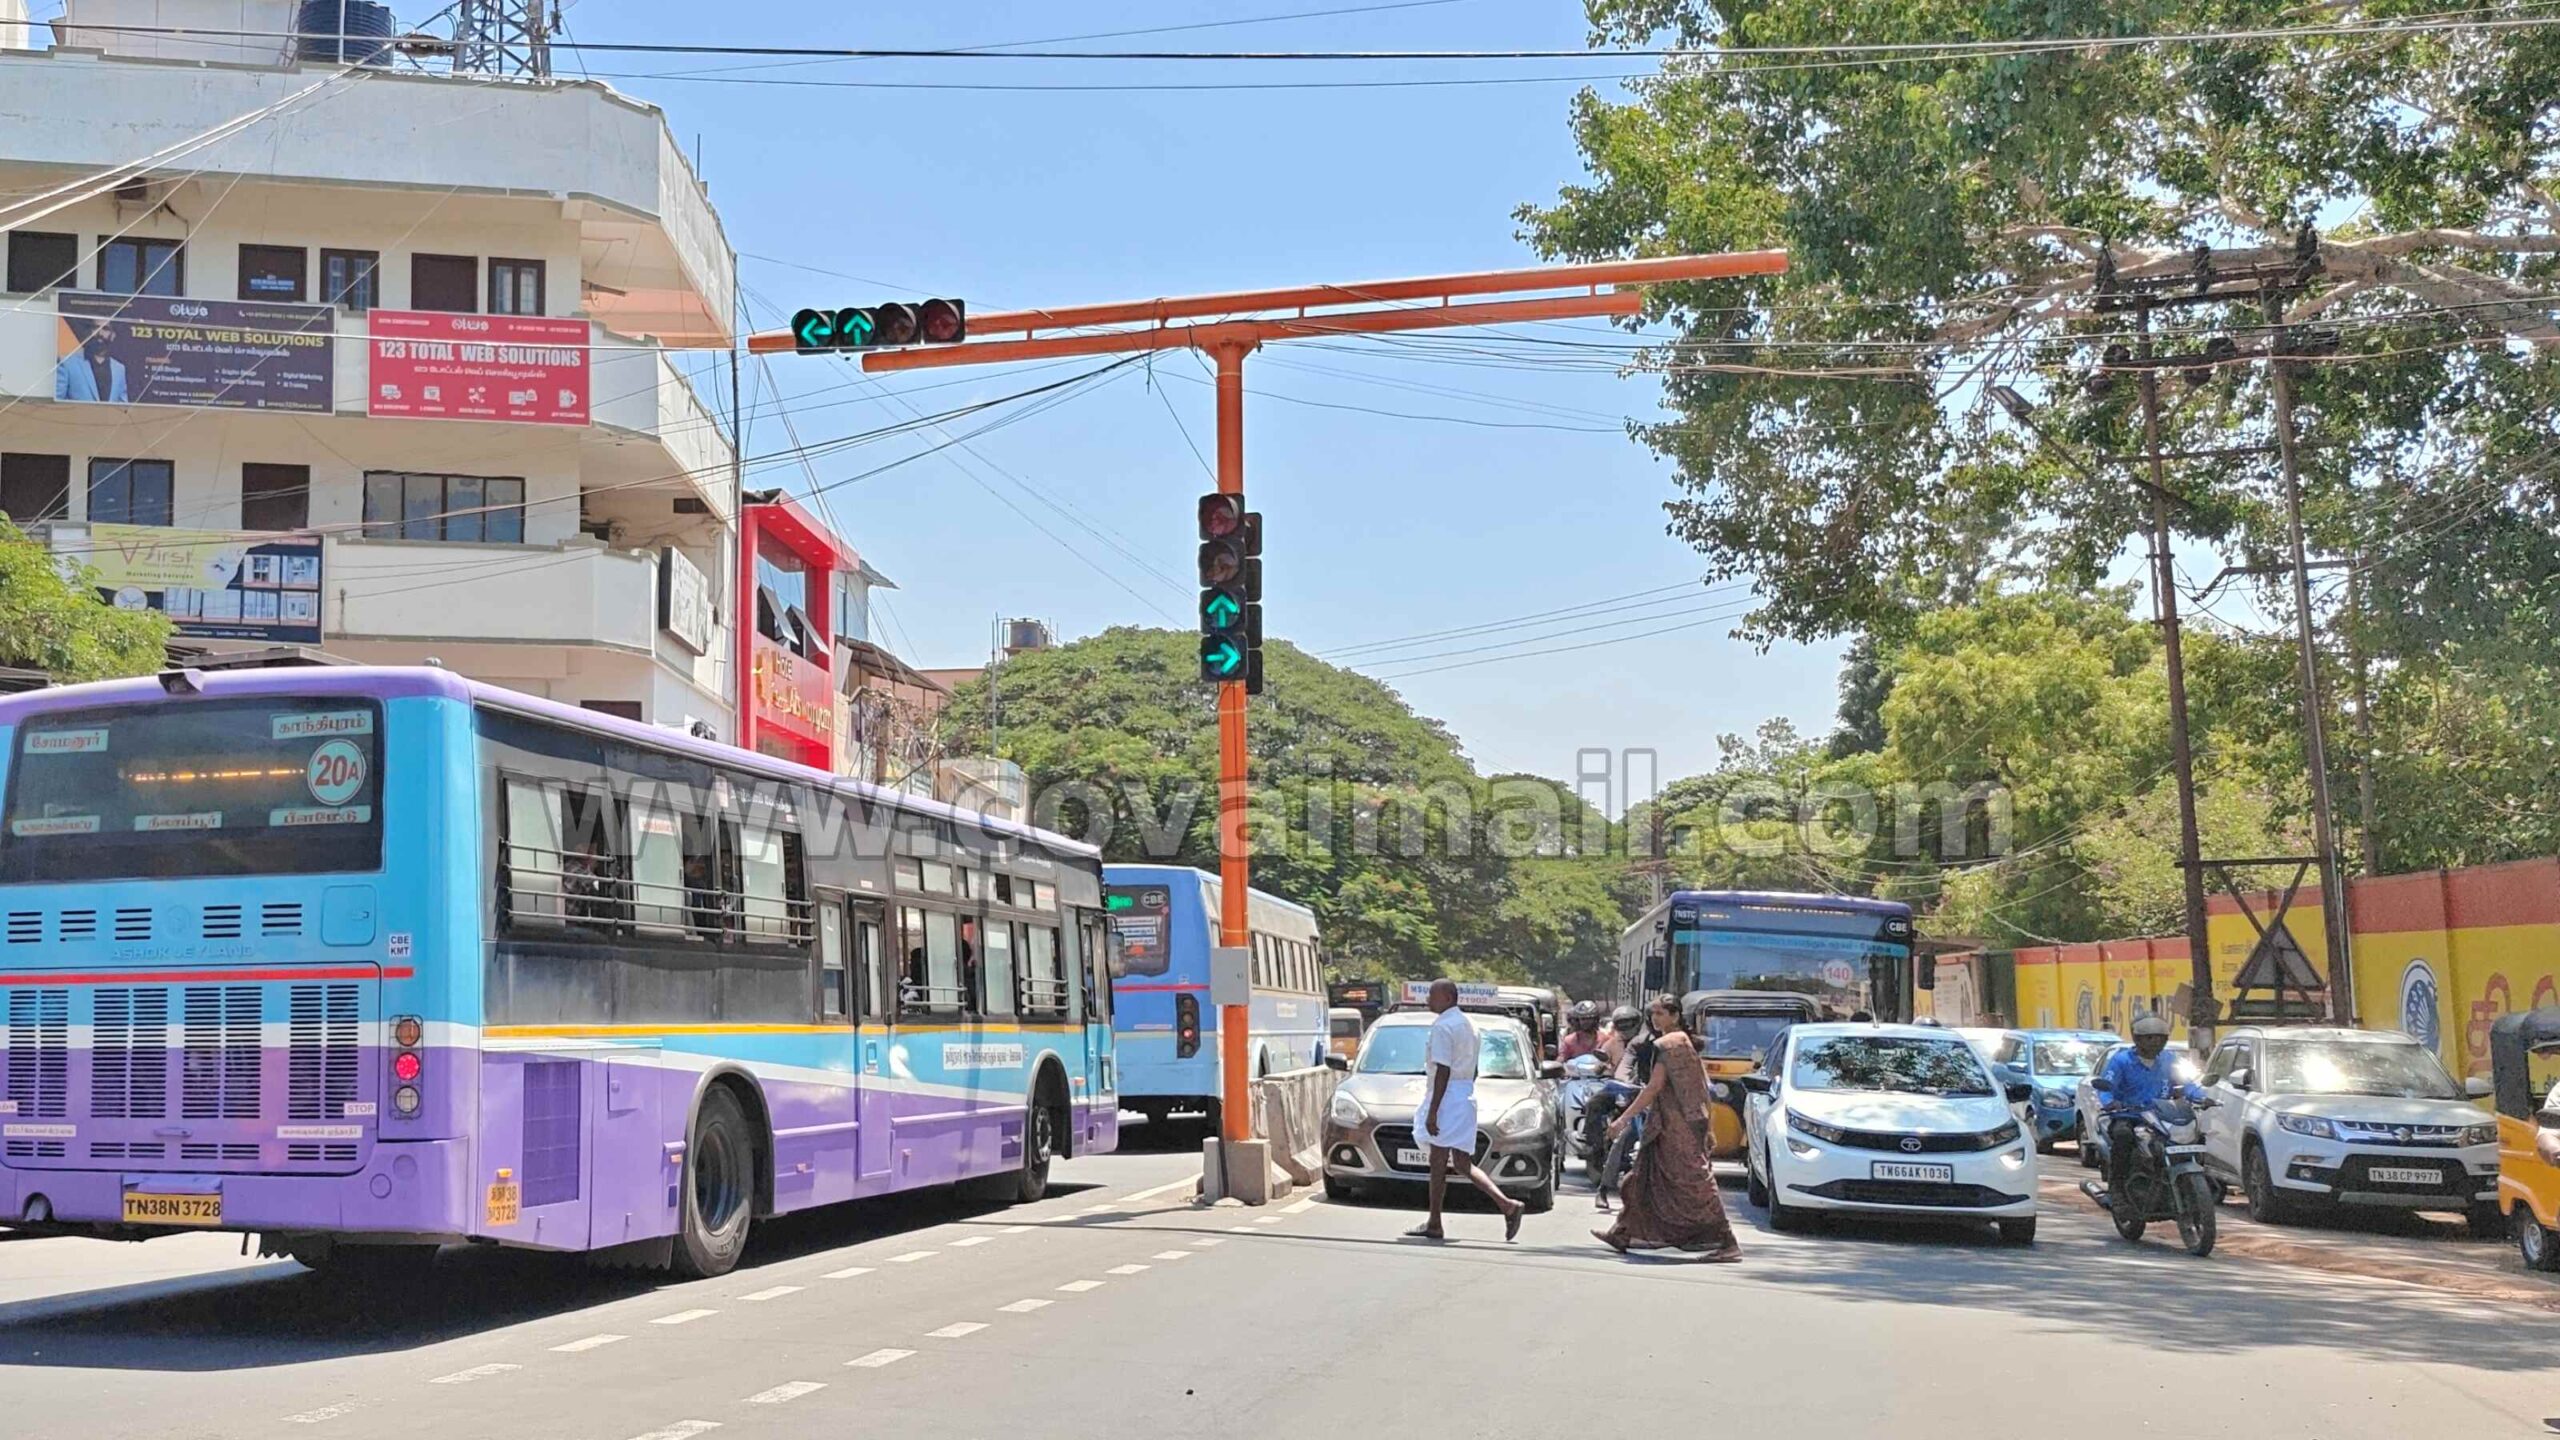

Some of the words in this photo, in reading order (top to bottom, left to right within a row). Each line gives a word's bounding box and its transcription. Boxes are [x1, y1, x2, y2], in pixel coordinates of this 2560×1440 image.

[131, 326, 153, 338] 123
[156, 328, 201, 341] TOTAL
[206, 330, 240, 344] WEB
[244, 331, 325, 347] SOLUTIONS
[378, 342, 406, 359] 123
[409, 343, 454, 361] TOTAL
[461, 345, 495, 363] WEB
[498, 346, 581, 367] SOLUTIONS
[277, 712, 368, 736] காந்திபுரம்
[314, 754, 360, 786] 20A
[1143, 894, 1165, 905] CBE
[1673, 909, 1698, 919] TNSTC
[1888, 921, 1908, 933] CBE
[390, 935, 410, 945] CBE
[390, 946, 410, 956] KMT
[1826, 966, 1850, 982] 140
[347, 1103, 374, 1114] STOP
[1880, 1165, 1950, 1179] TN66AK1036
